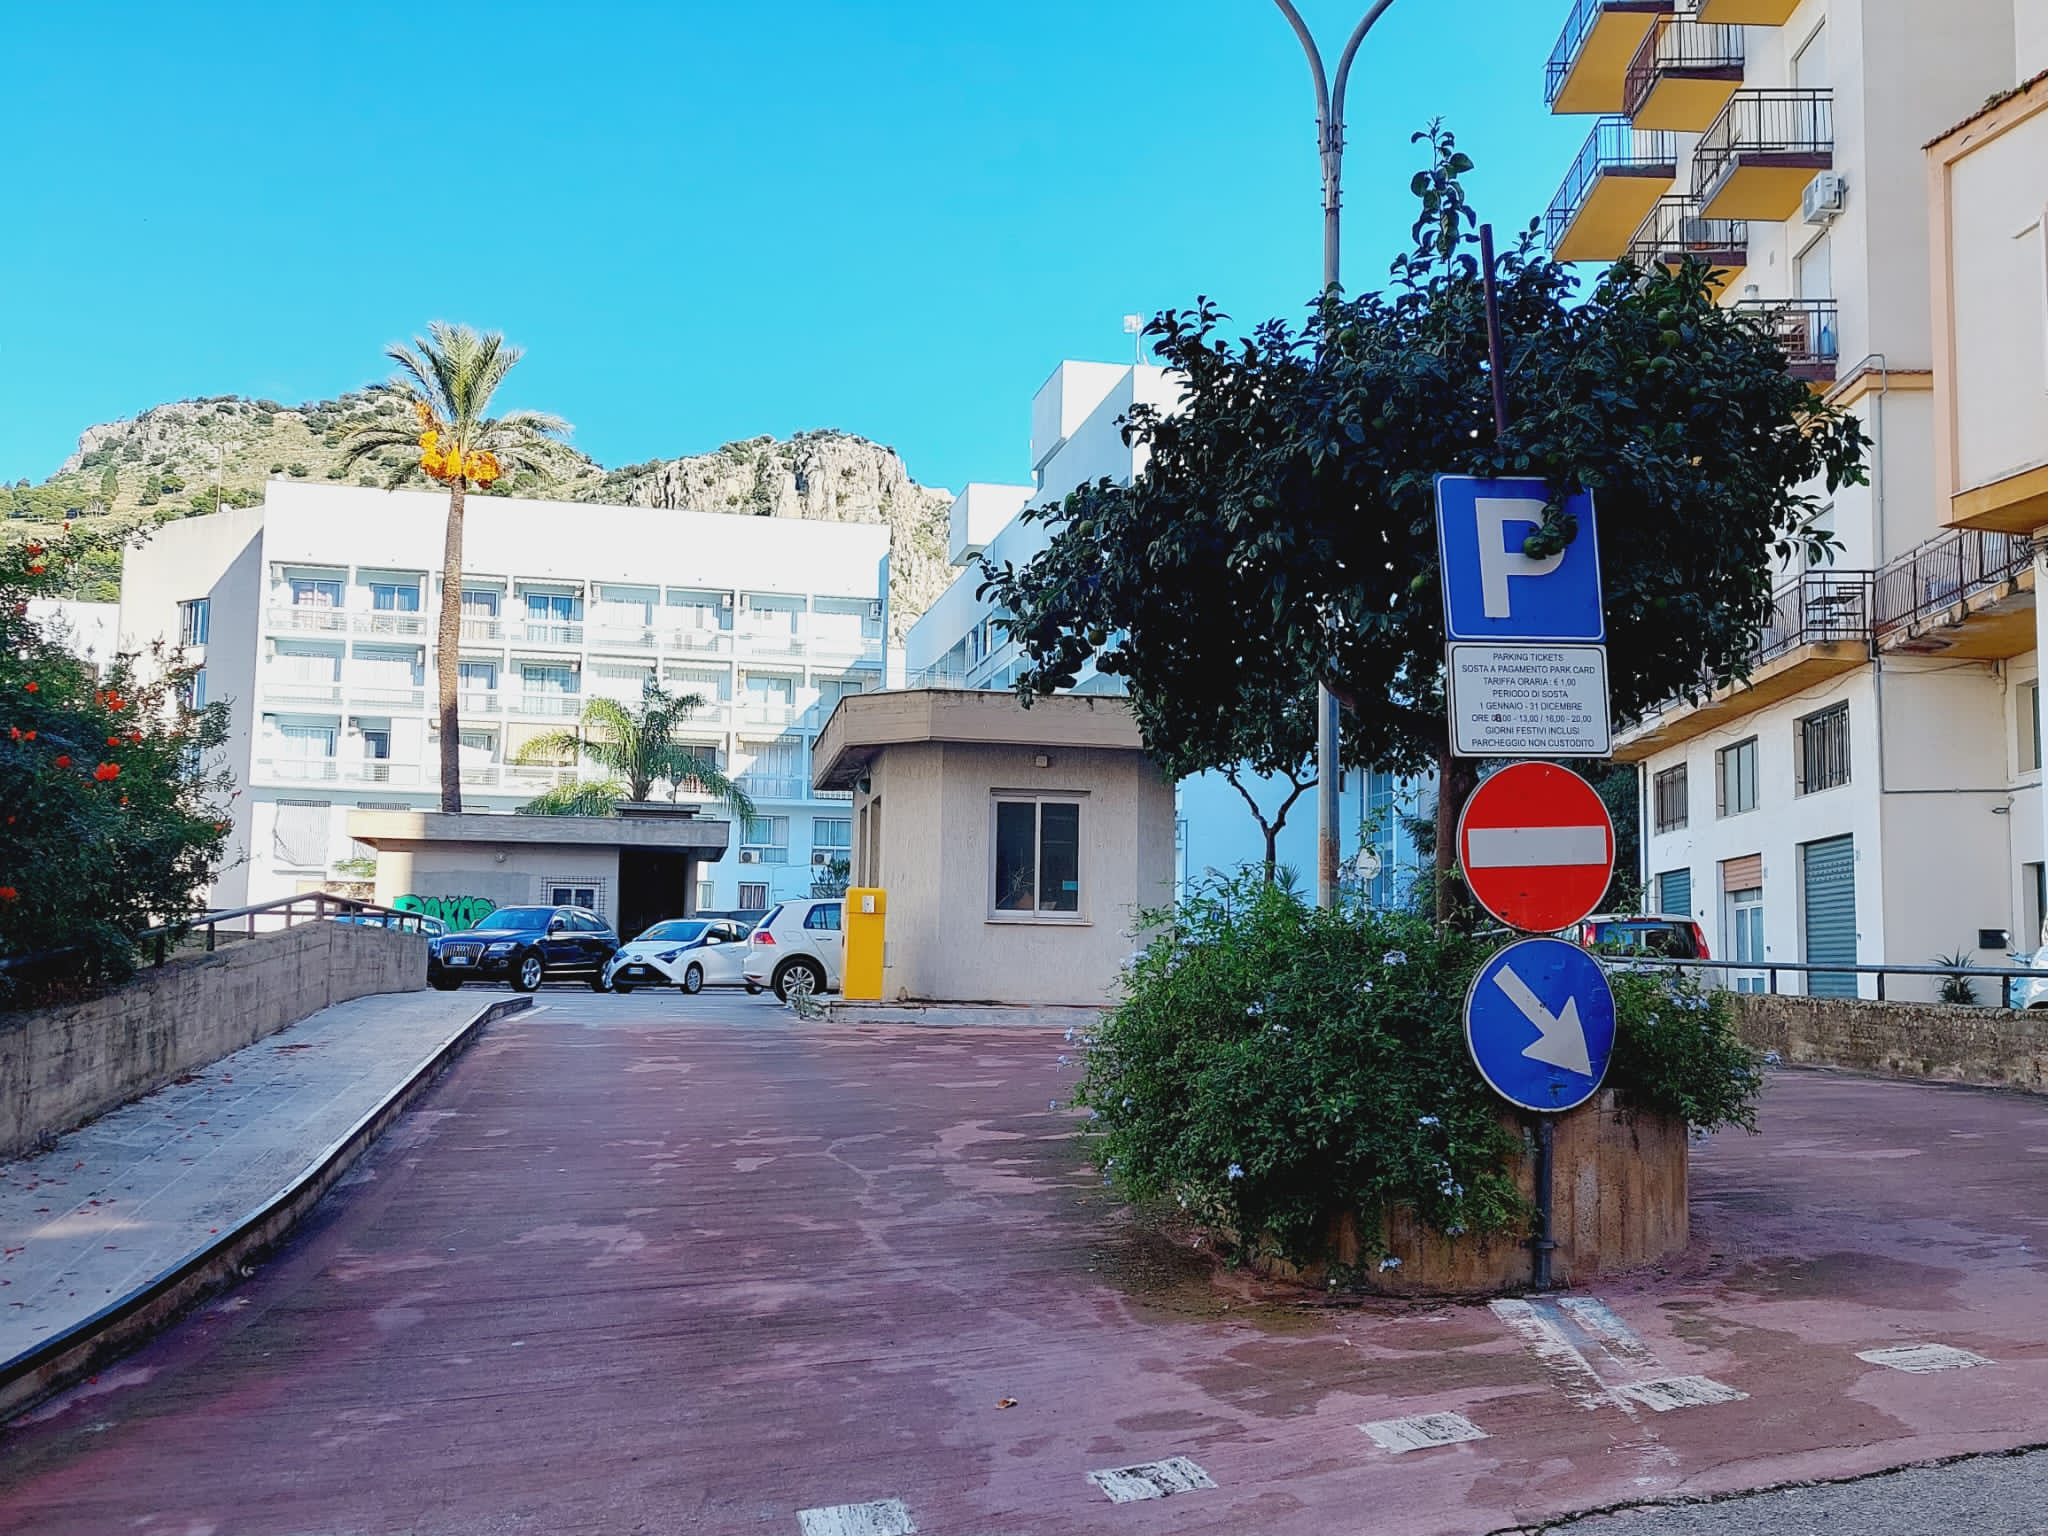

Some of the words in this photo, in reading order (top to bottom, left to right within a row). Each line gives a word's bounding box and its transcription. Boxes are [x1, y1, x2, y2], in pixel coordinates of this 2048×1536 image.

[1475, 497, 1566, 618] P
[1492, 652, 1529, 661] PARKING
[1530, 653, 1564, 661] TICKETS
[1462, 664, 1489, 673] SOSTA
[1490, 665, 1495, 673] A
[1498, 665, 1550, 673] PAGAMENTO
[1550, 666, 1571, 674] PARK
[1572, 666, 1595, 674] CARD
[1482, 677, 1516, 685] TARIFFA
[1492, 689, 1529, 698] PERIODO
[1531, 690, 1540, 698] DI
[1542, 690, 1569, 698] SOSTA
[1486, 702, 1523, 710] GENNAIO
[1530, 702, 1539, 710] 31
[1540, 702, 1583, 711] DICEMBRE
[1471, 714, 1488, 722] ORE
[1485, 726, 1514, 734] GIORNI
[1516, 727, 1547, 735] FESTIVI
[1548, 727, 1580, 735] INCLUSI
[1471, 739, 1526, 747] PARCHEGGIO
[1528, 739, 1546, 748] NON
[1547, 739, 1595, 748] CUSTODITO
